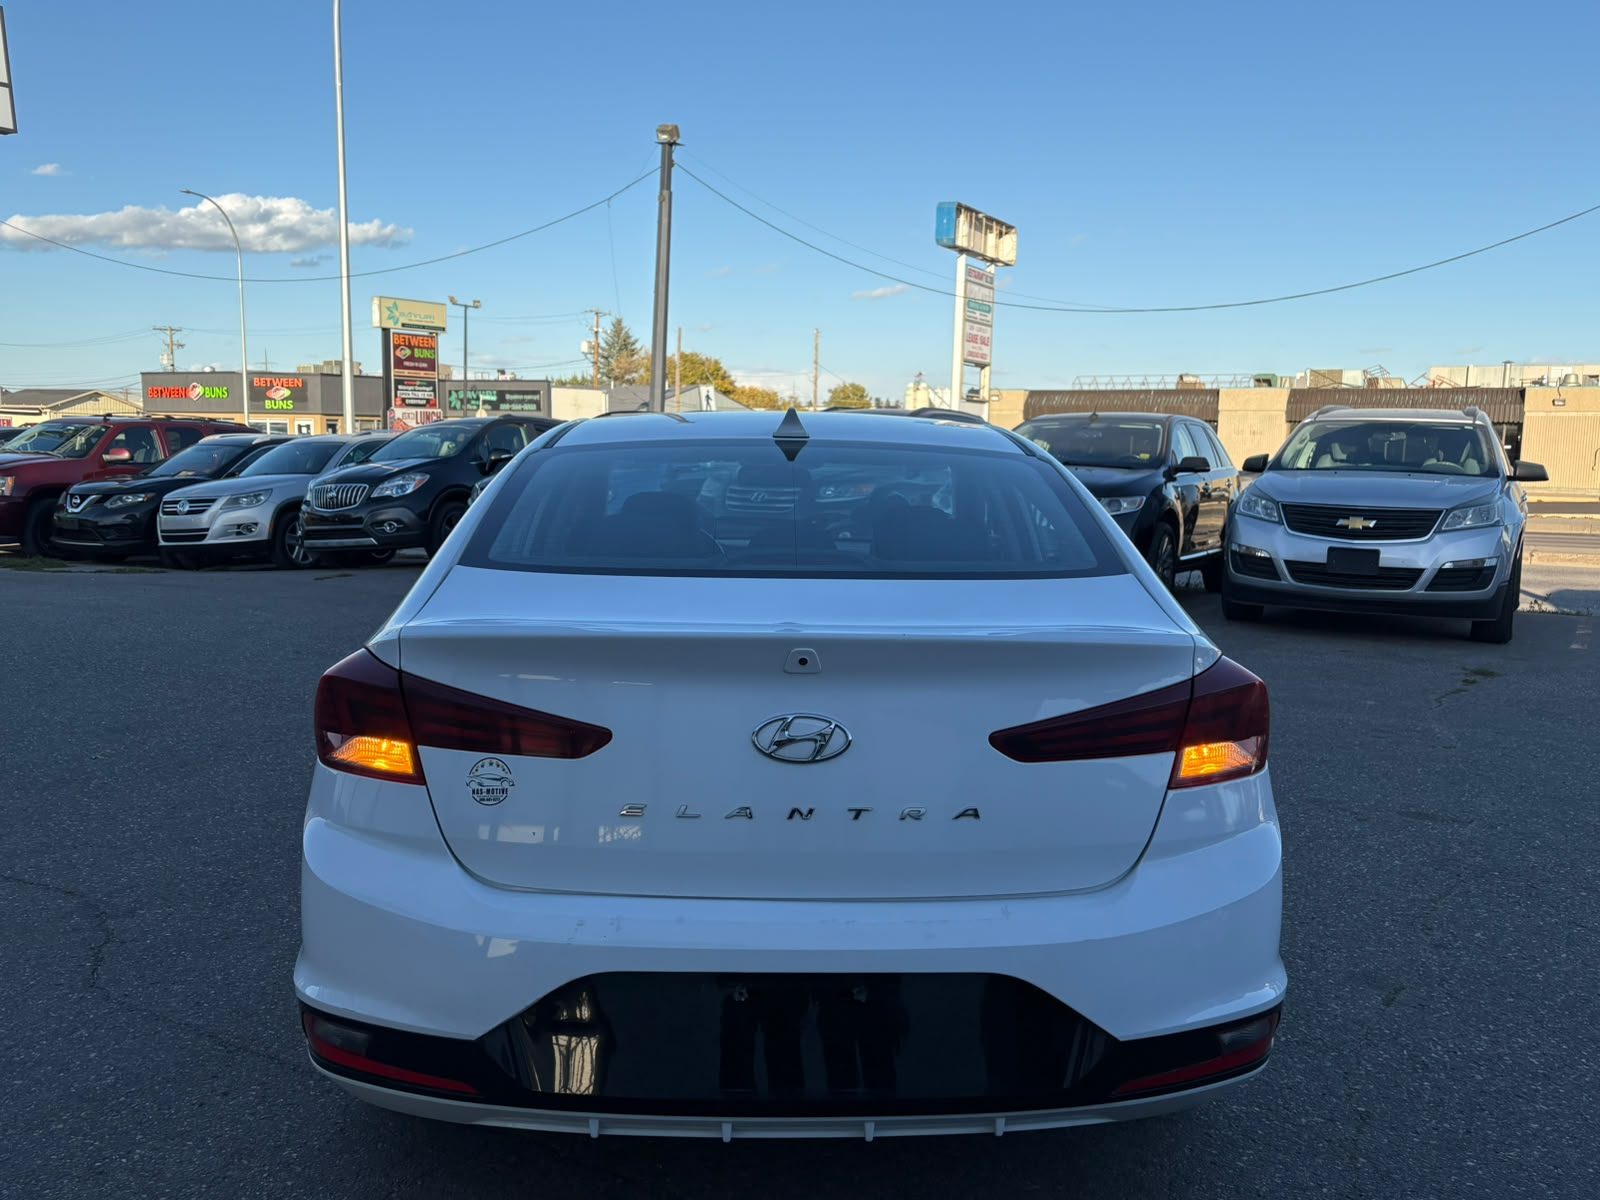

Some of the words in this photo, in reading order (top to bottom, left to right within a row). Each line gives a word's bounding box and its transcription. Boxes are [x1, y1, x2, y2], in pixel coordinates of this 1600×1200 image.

[394, 335, 435, 348] BETWEEN
[414, 349, 435, 359] BUNS
[253, 377, 303, 387] BETWEEN
[148, 387, 187, 399] BETWEEN
[205, 386, 228, 399] BUNS
[264, 400, 294, 410] BUNS
[415, 410, 442, 425] LUNCH
[619, 803, 981, 821] ELANTRA
